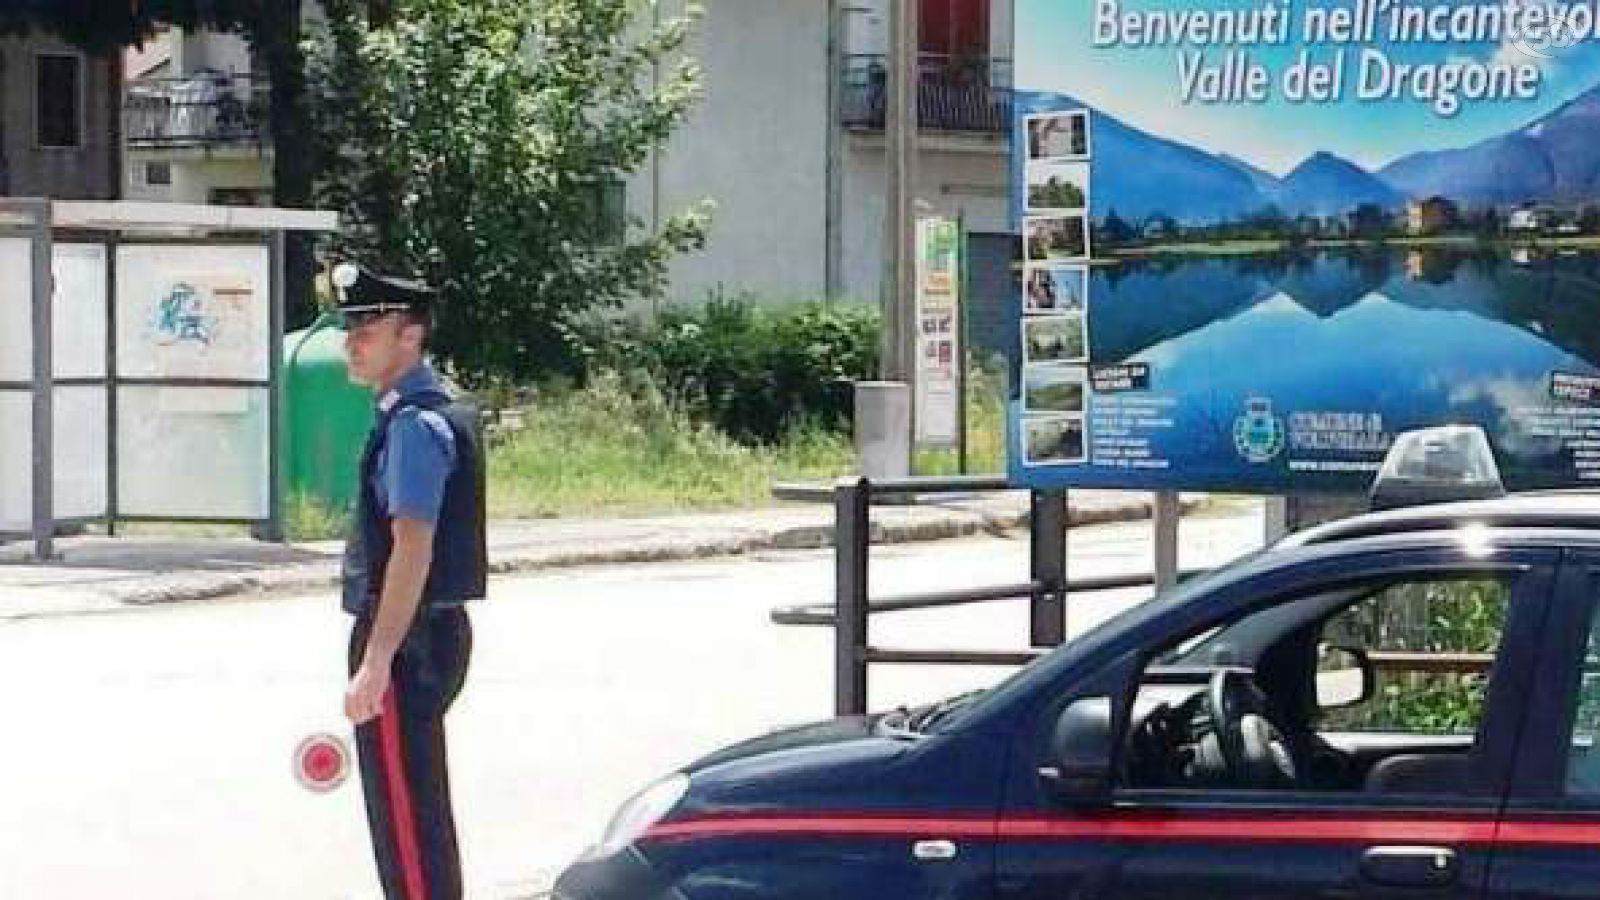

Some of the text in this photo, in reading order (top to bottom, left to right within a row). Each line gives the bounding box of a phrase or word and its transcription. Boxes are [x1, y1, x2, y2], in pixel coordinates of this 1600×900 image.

[1095, 0, 1289, 45] Benvenuti
[1176, 48, 1541, 116] Valle del Dragone
